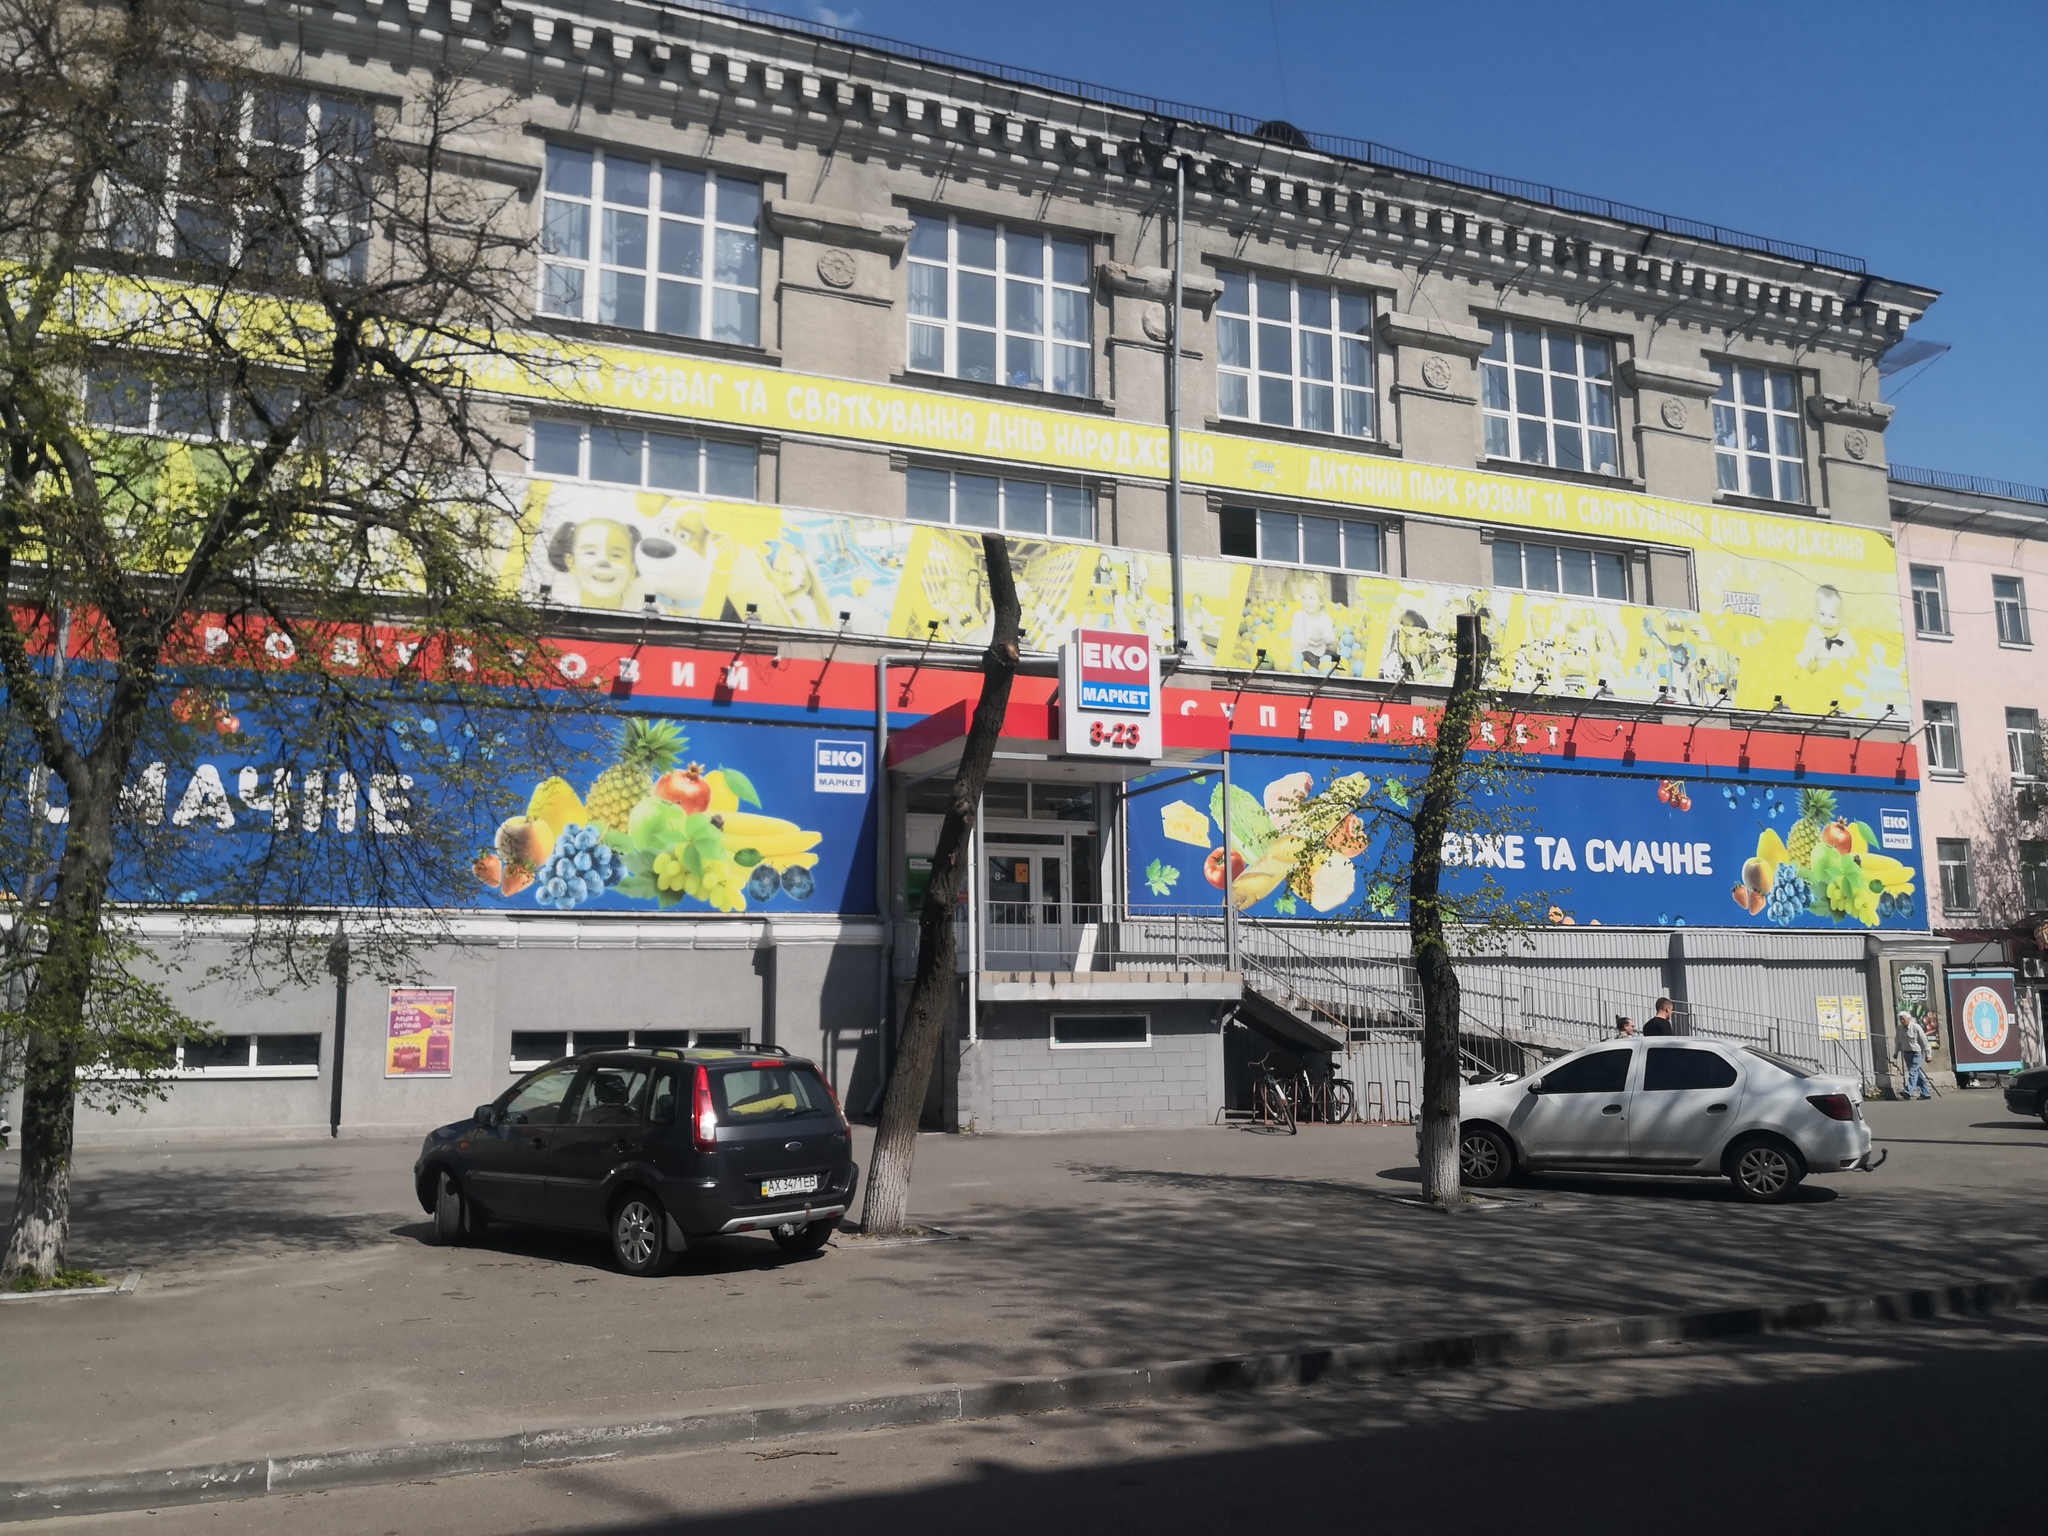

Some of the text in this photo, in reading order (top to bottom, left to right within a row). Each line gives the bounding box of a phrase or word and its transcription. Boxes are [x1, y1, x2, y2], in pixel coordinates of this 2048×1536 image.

[613, 362, 724, 409] РОЗВАГ
[734, 379, 768, 414] ТА
[786, 385, 974, 444] СВЯТКУВАННЯ
[984, 412, 1046, 453] ДНІВ
[1054, 423, 1214, 476] НАРОДЖЕНЯ
[1307, 456, 1402, 499] ДИТЯЧИЙ
[1409, 471, 1459, 506] ПАРК
[1465, 481, 1536, 516] РОЗВАГ
[1543, 491, 1566, 520] ТА
[1578, 496, 1703, 540] СВЯТКУВАННЯ
[1710, 514, 1750, 546] ДНІВ
[1754, 521, 1864, 561] НАРОДЖЕННЯ
[1083, 687, 1148, 705] МАРКЕТ
[1091, 721, 1140, 745] 8-23
[1180, 699, 1559, 746] СУПЕРМАКЕТ
[818, 778, 862, 787] МАРКЕТ
[1884, 837, 1909, 845] МАРКЕТ
[1534, 836, 1576, 871] ТА
[1585, 838, 1713, 875] СМАЧНЕ
[768, 1180, 781, 1192] AX
[804, 1175, 816, 1188] EB
